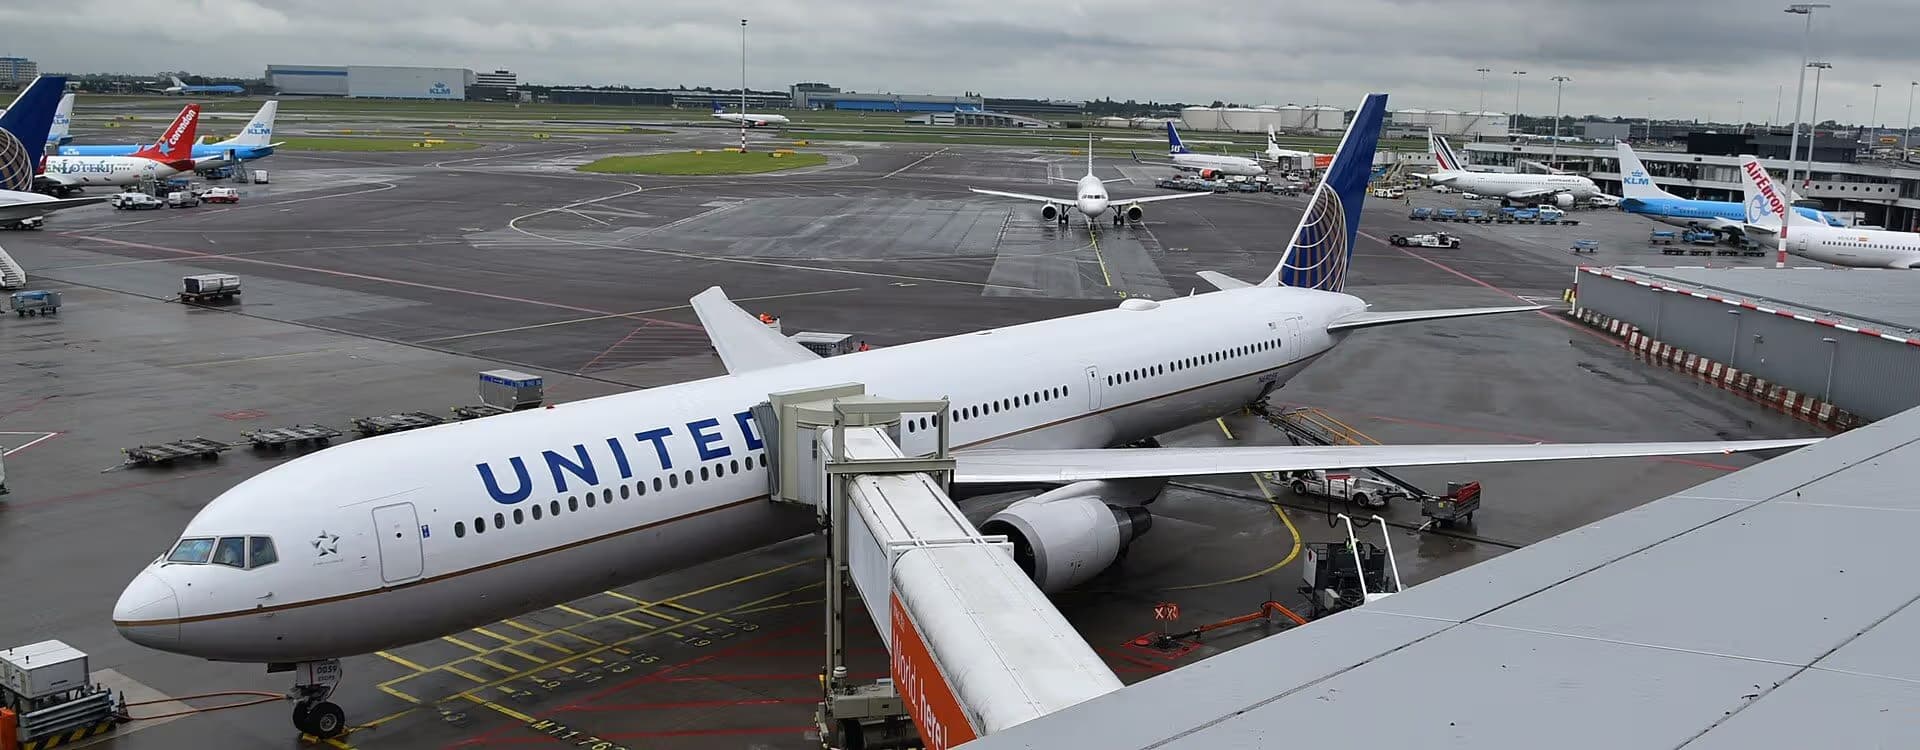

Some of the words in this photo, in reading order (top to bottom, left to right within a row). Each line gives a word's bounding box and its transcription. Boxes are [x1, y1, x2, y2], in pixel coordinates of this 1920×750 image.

[169, 109, 196, 145] corendon
[1624, 177, 1649, 185] KLM
[893, 629, 919, 719] World,
